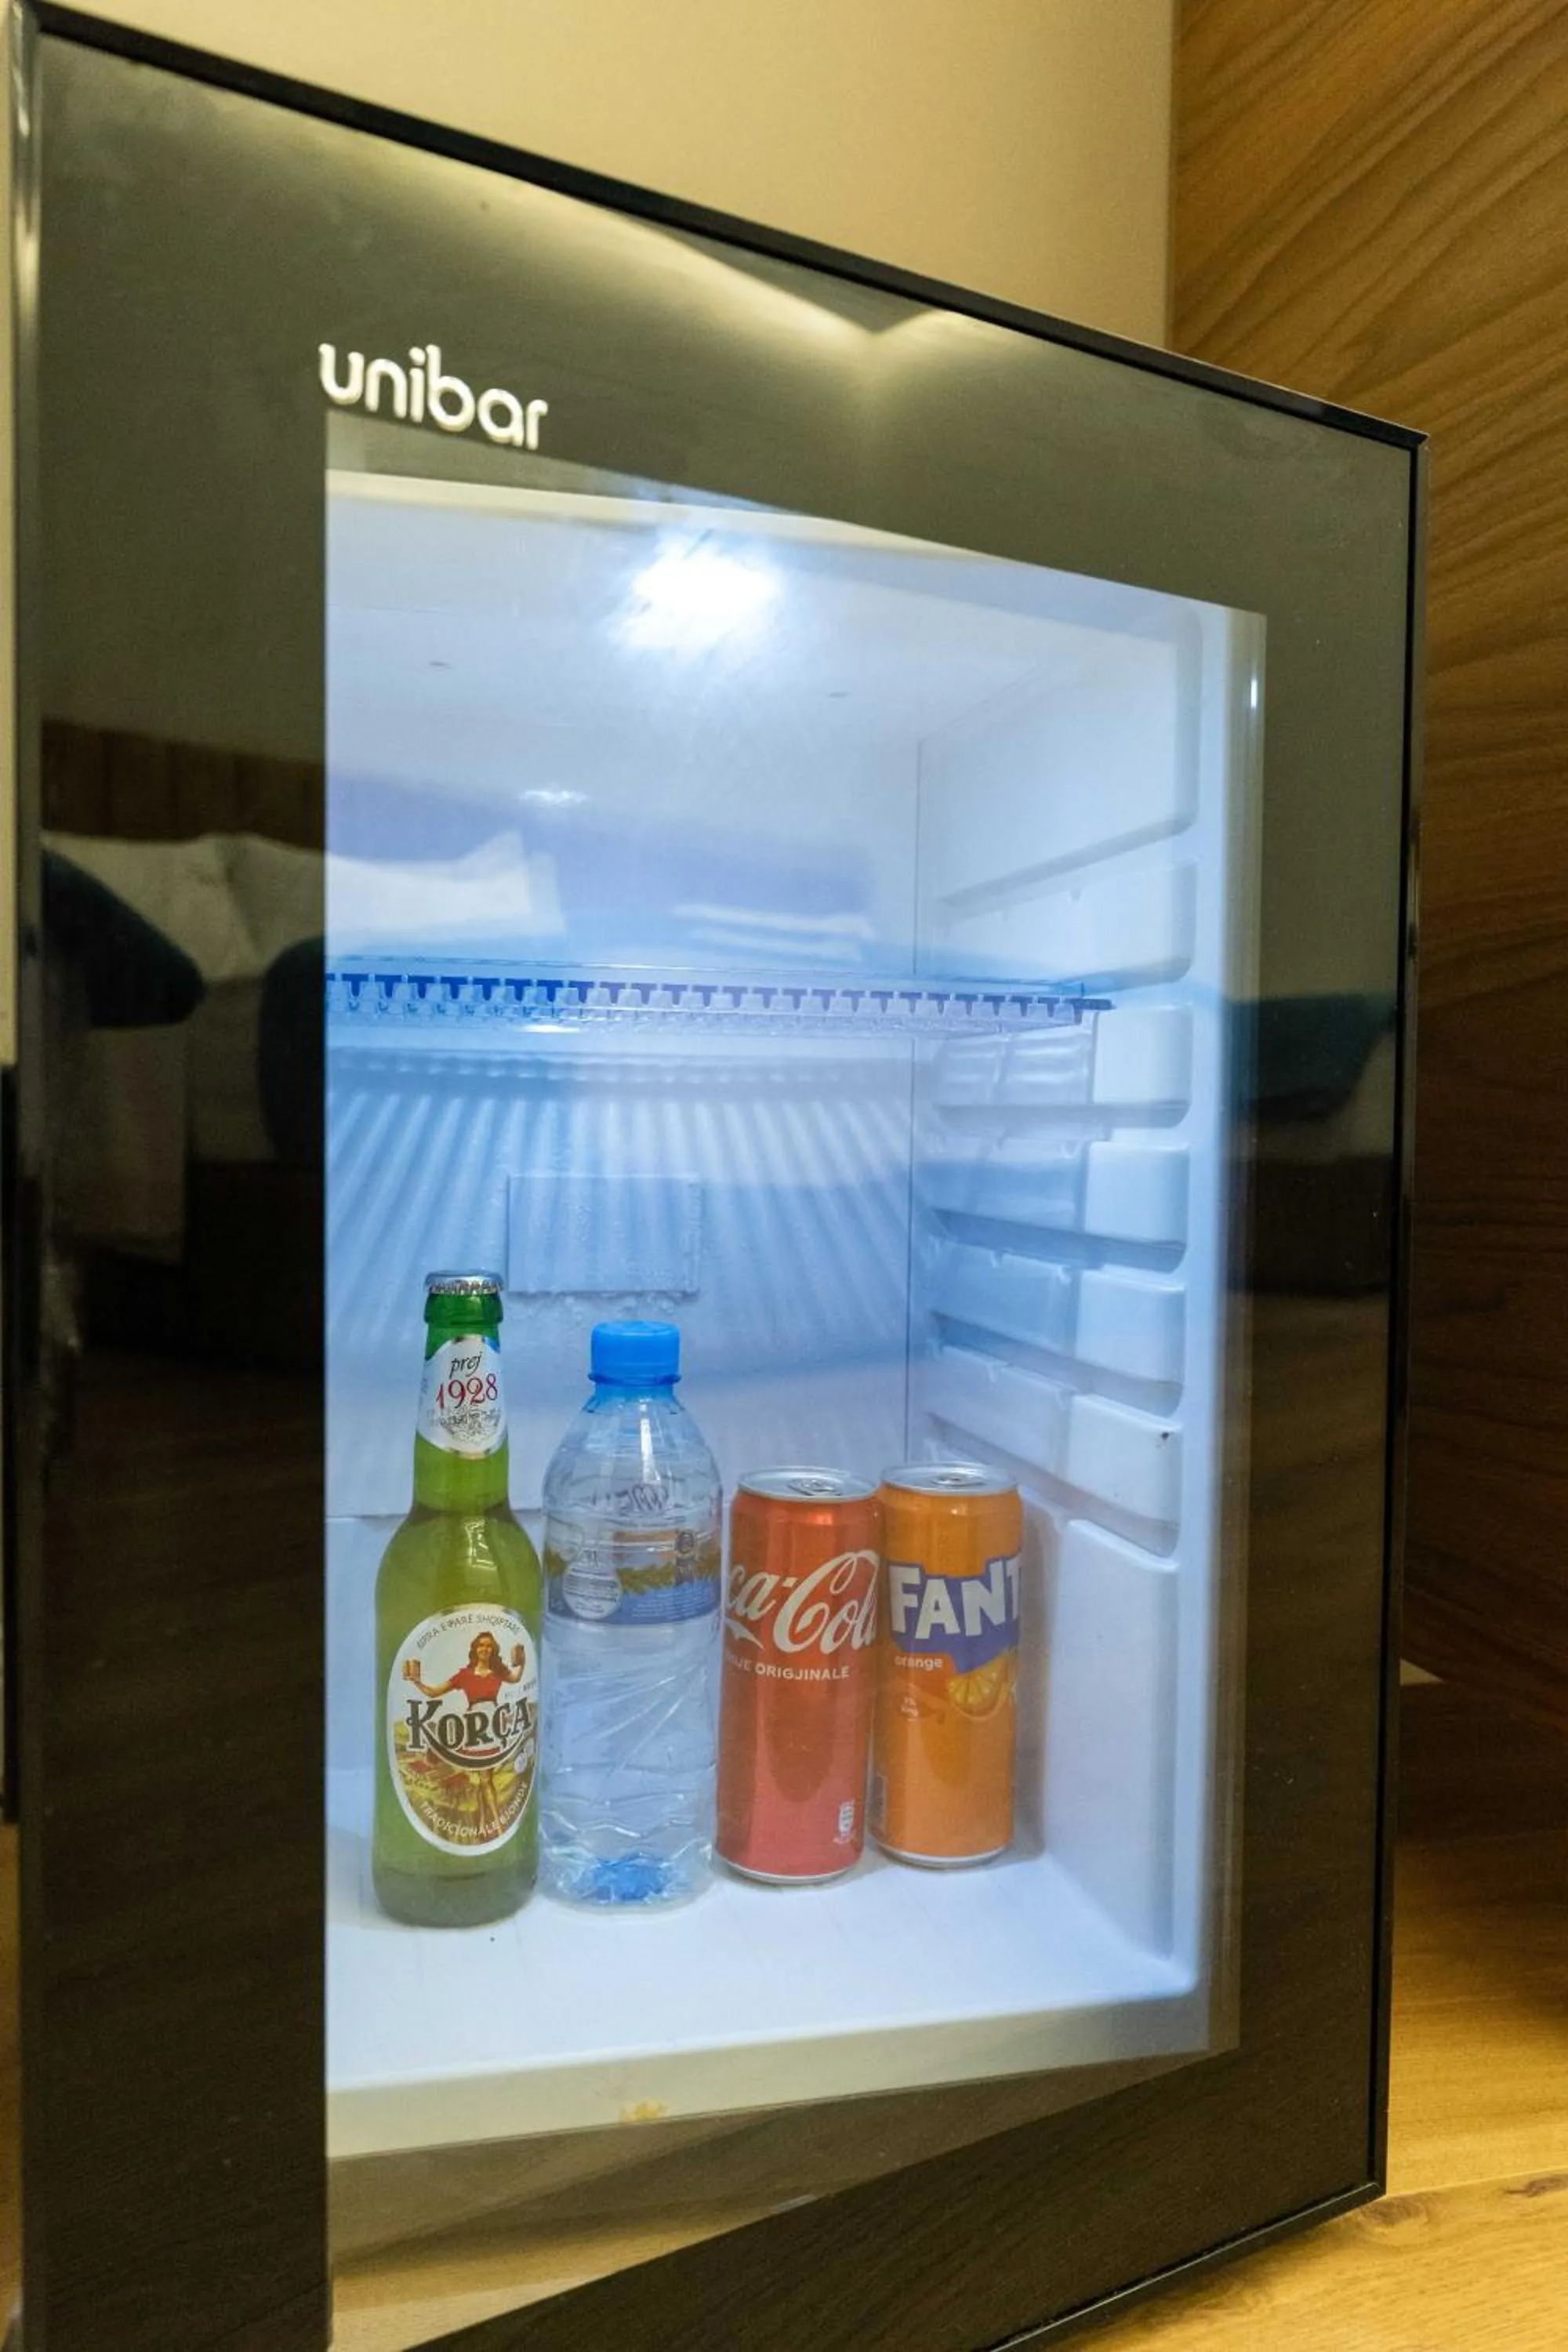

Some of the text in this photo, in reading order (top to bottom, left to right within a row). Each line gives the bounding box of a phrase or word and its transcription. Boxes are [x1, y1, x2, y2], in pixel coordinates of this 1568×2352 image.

[318, 343, 548, 451] unibar
[449, 1351, 484, 1379] prej
[435, 1373, 499, 1410] 1928
[754, 1662, 850, 1681] ORIGJINALE
[894, 1655, 942, 1671] orange
